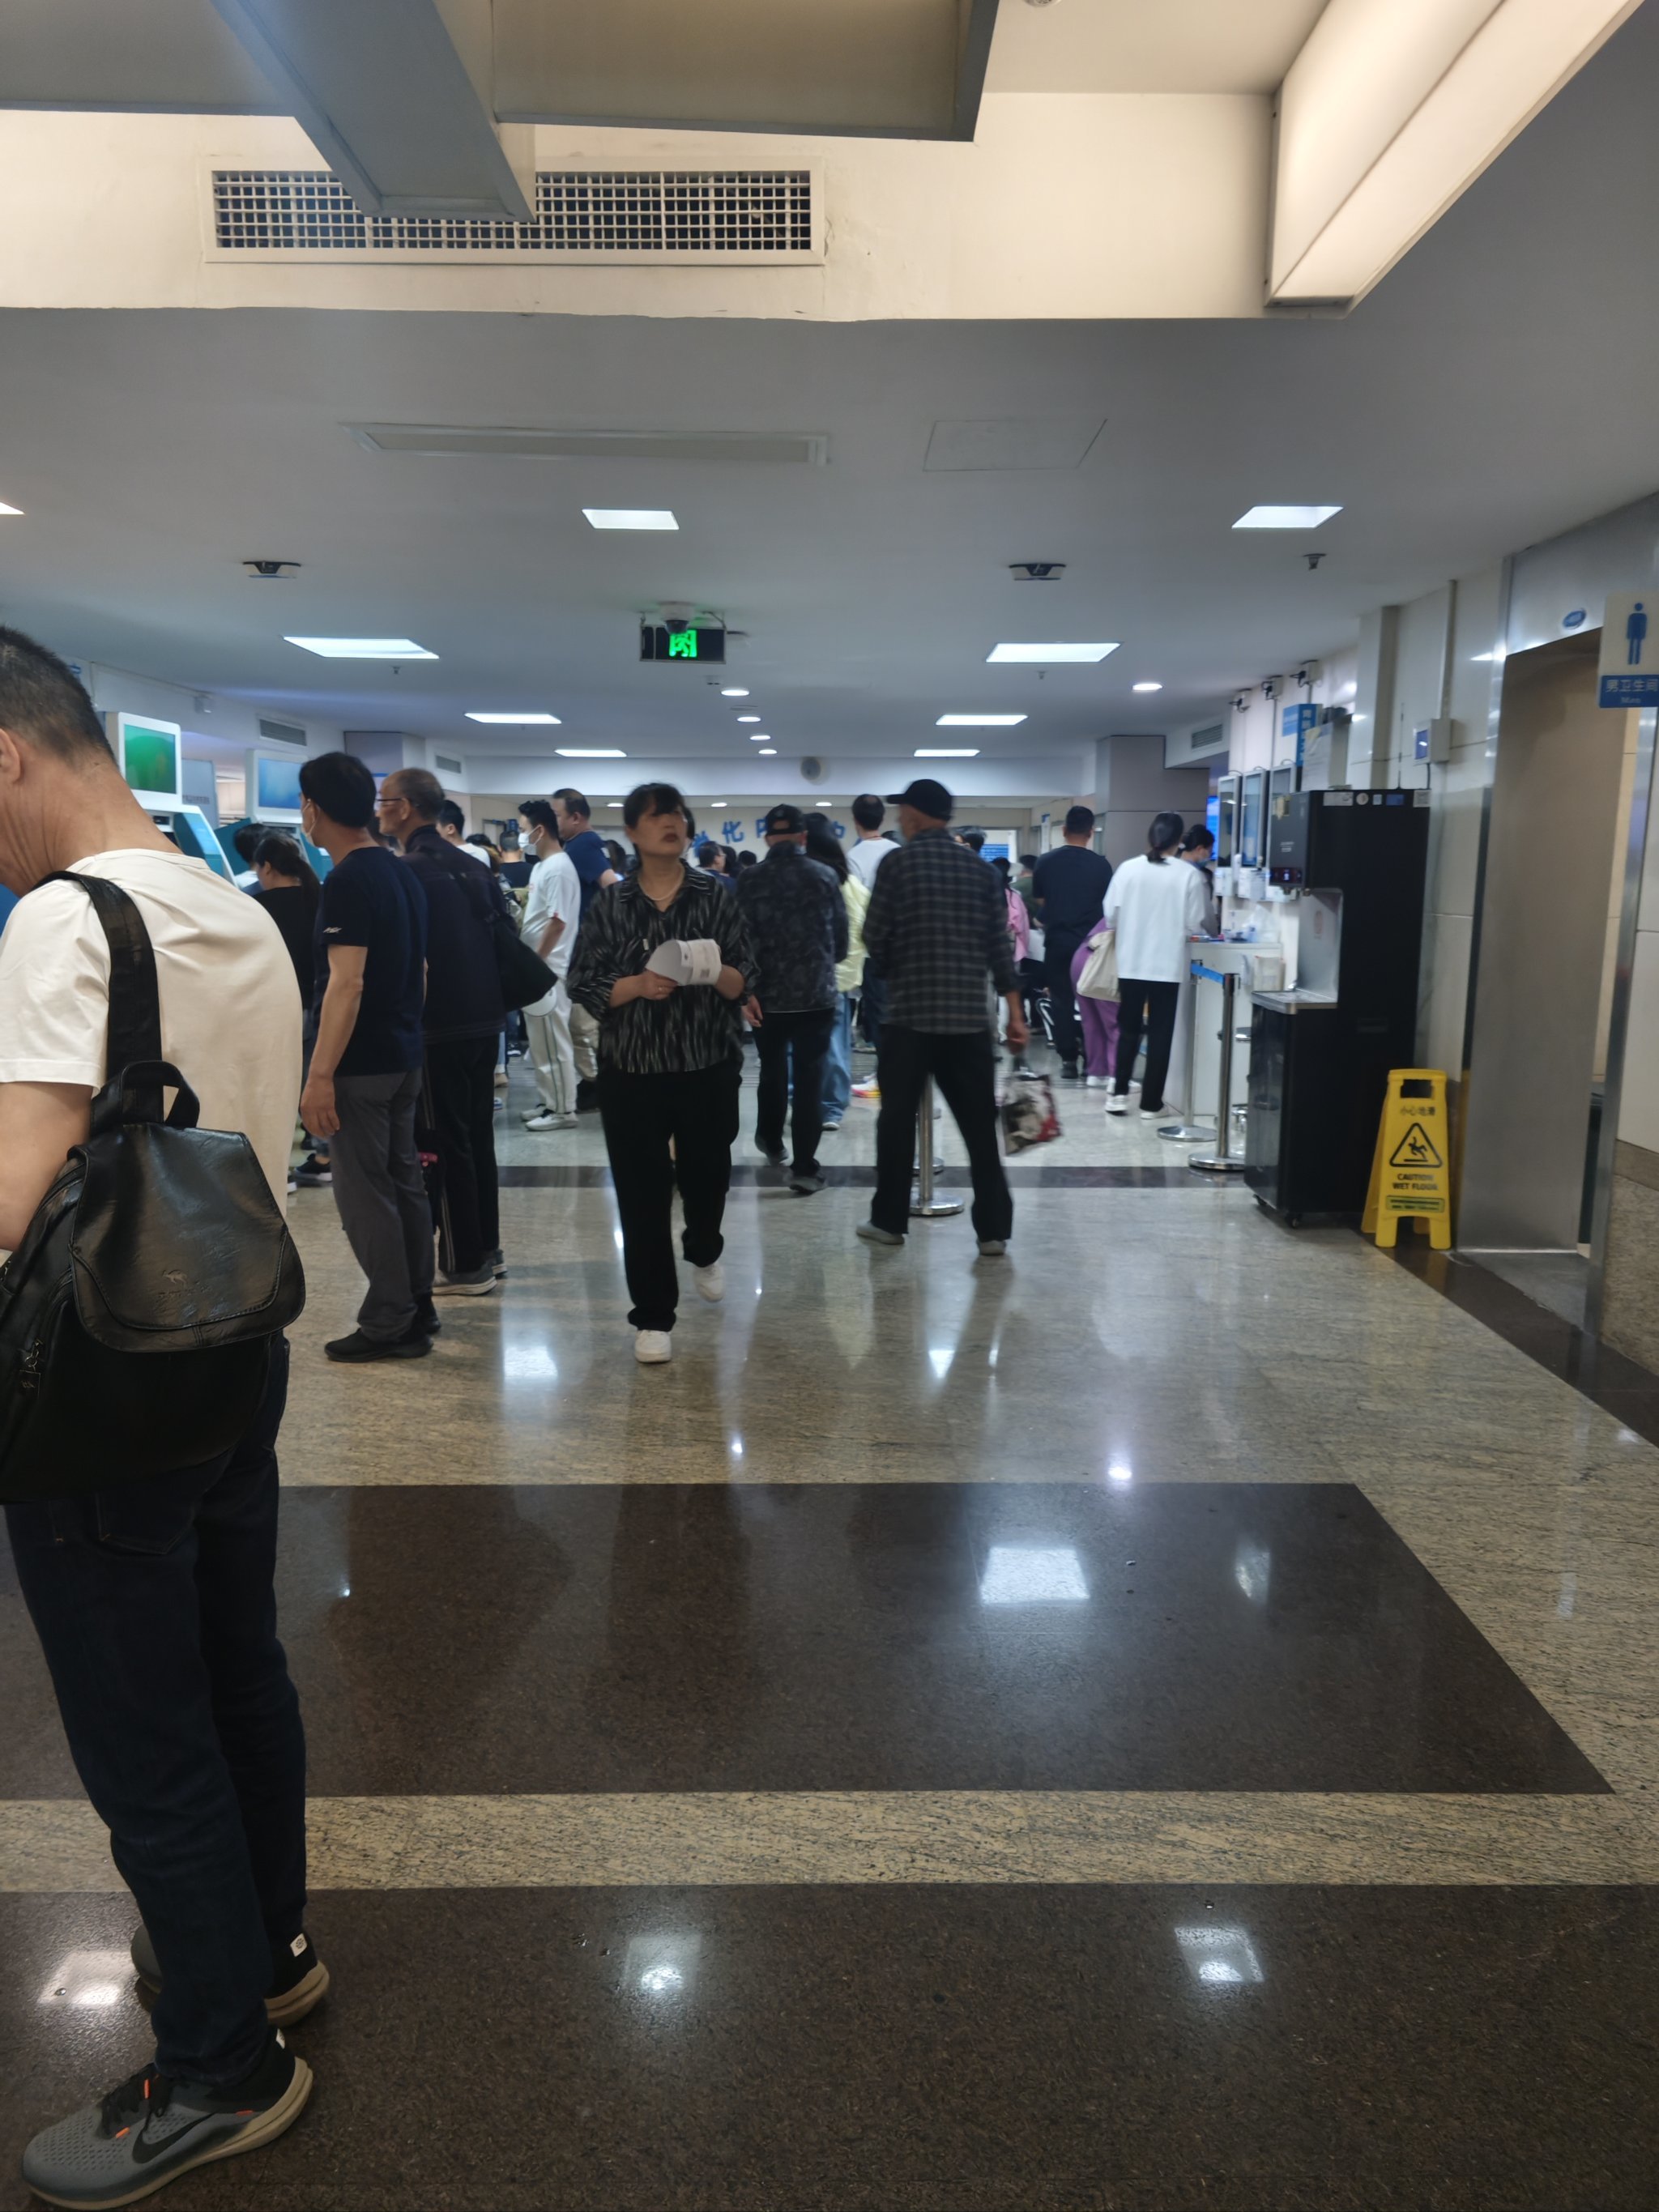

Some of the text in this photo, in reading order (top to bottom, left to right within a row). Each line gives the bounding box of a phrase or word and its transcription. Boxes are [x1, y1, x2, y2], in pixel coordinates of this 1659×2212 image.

[1606, 679, 1658, 693] 男卫生间
[1400, 1106, 1436, 1116] 小心地滑
[1397, 1173, 1434, 1181] CAUTION
[1412, 1183, 1439, 1191] FLOOR
